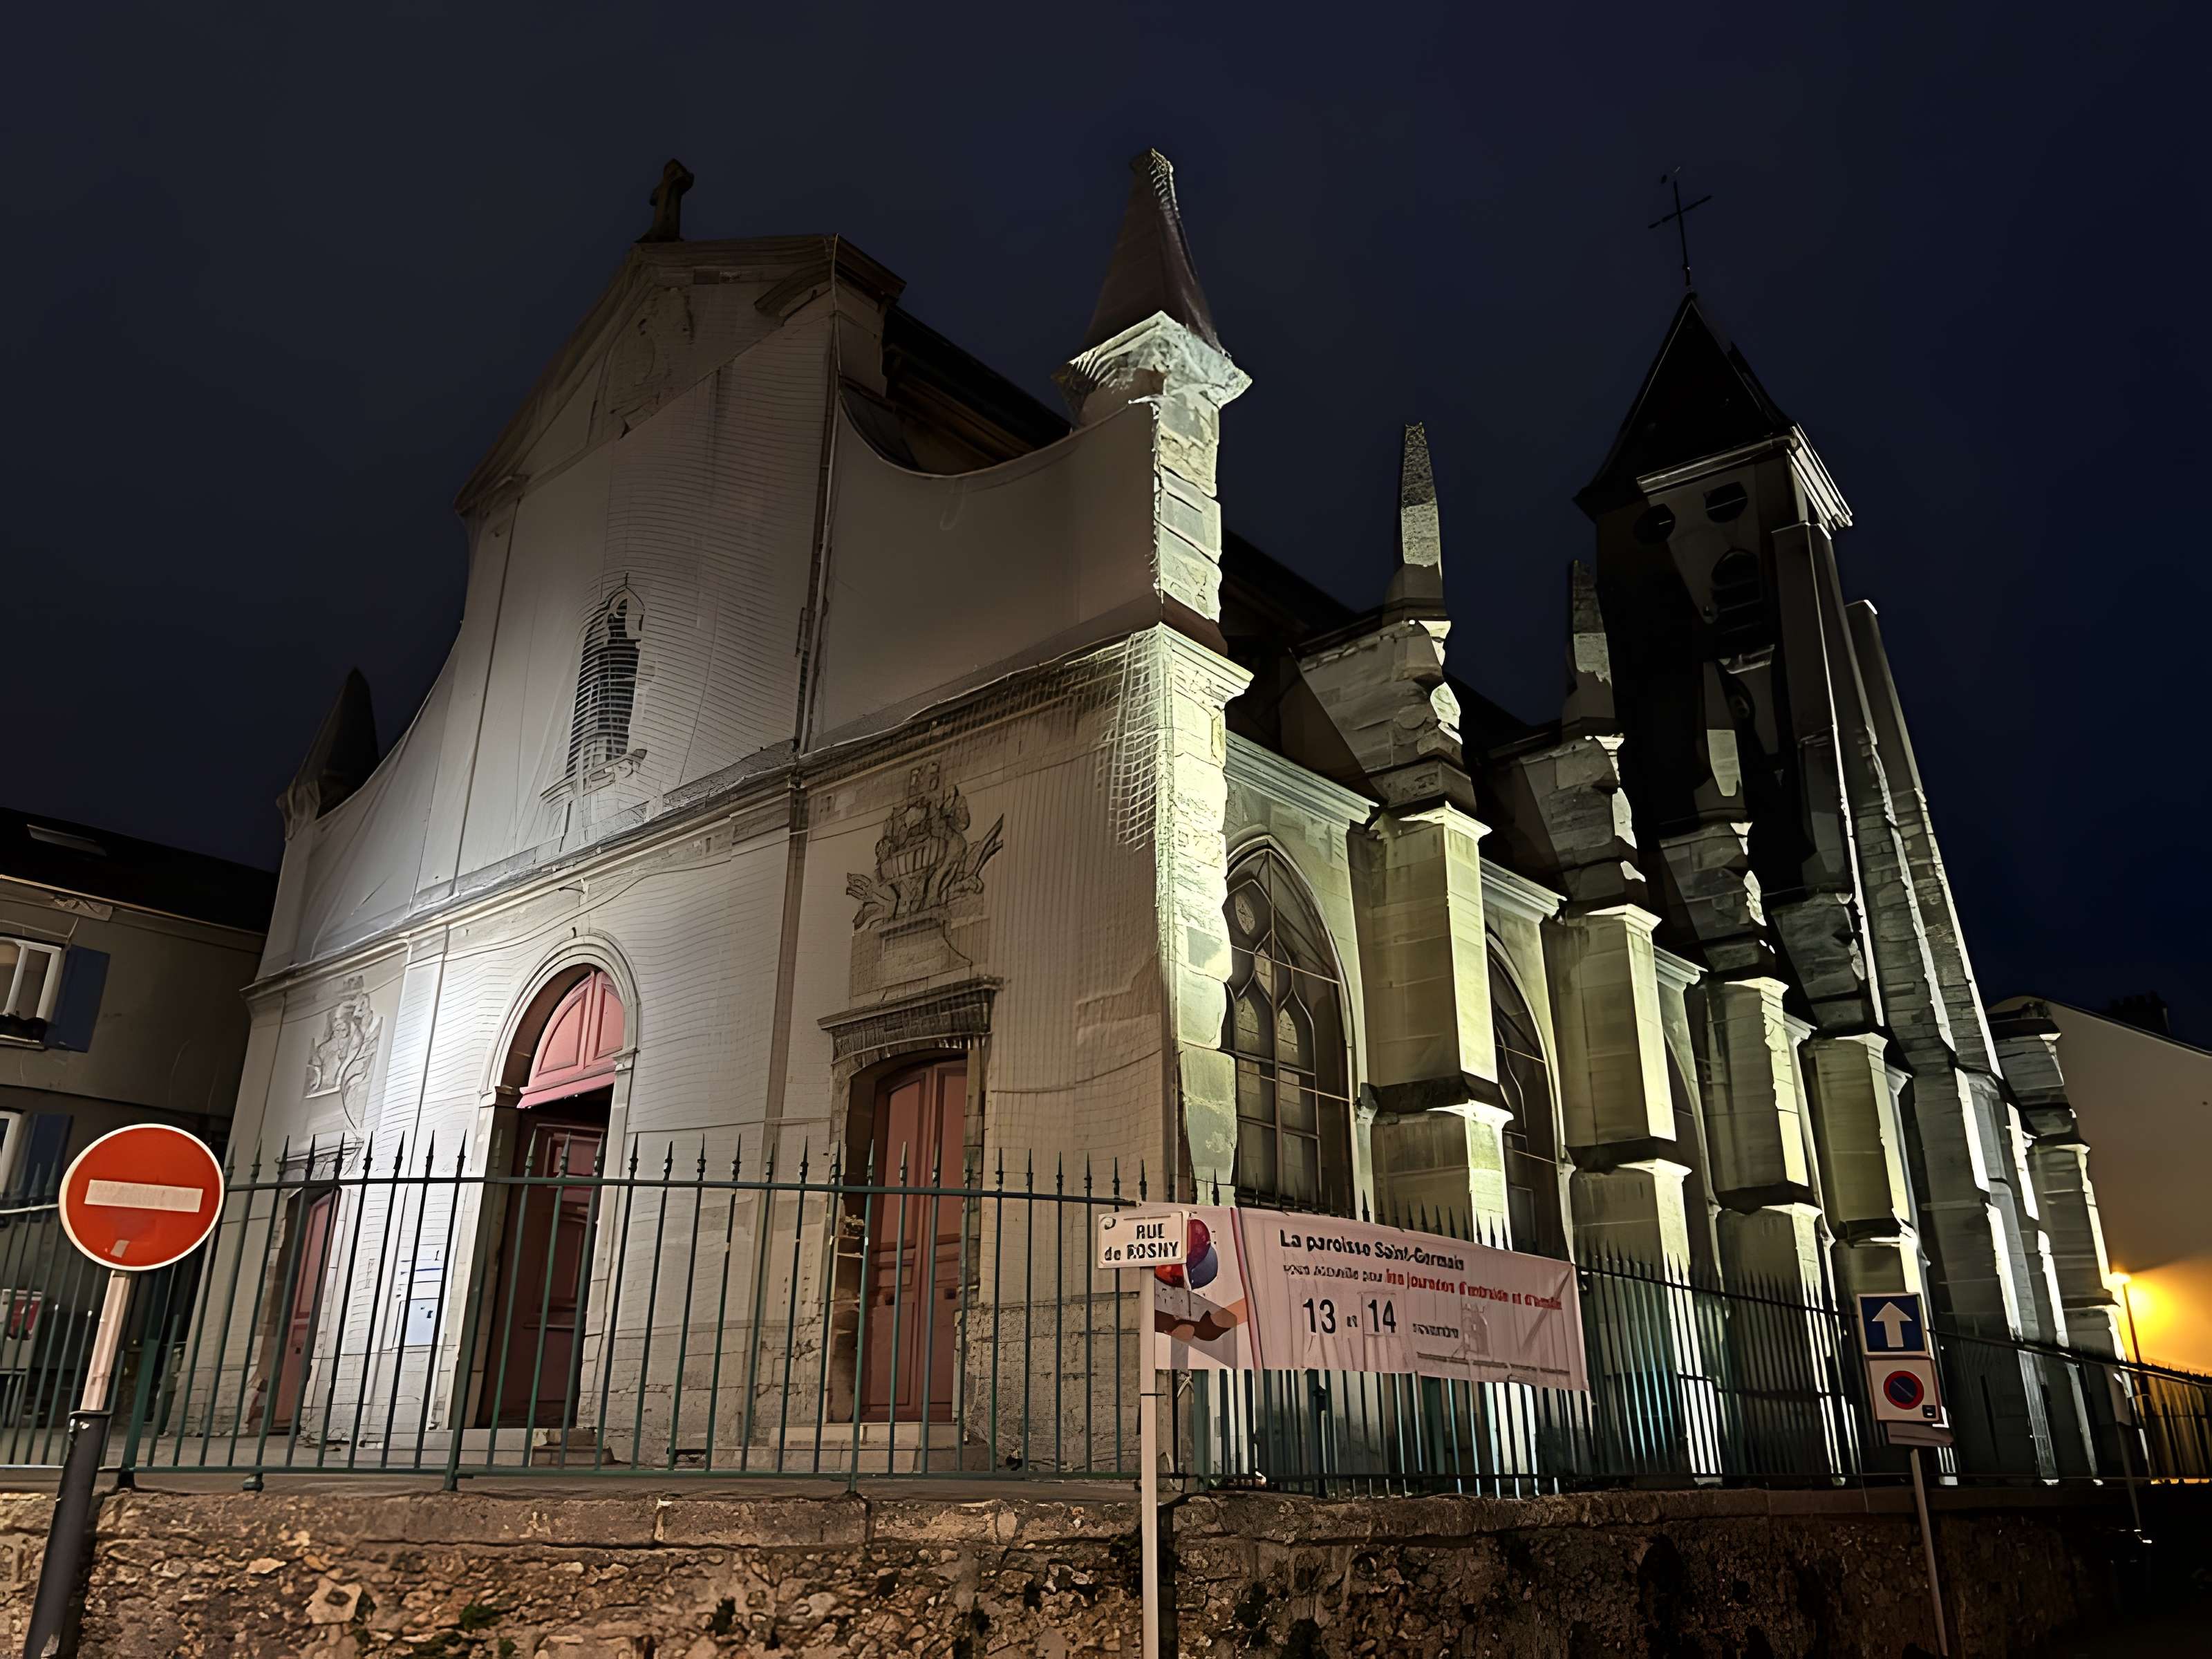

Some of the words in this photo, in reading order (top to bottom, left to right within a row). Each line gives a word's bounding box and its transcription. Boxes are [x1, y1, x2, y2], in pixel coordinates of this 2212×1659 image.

[1136, 1223, 1165, 1239] RUE
[1280, 1229, 1302, 1248] La
[1306, 1236, 1371, 1257] paroisse
[1104, 1246, 1121, 1261] de
[1126, 1241, 1179, 1259] ROSNY
[1302, 1298, 1336, 1334] 13
[1367, 1299, 1396, 1333] 14
